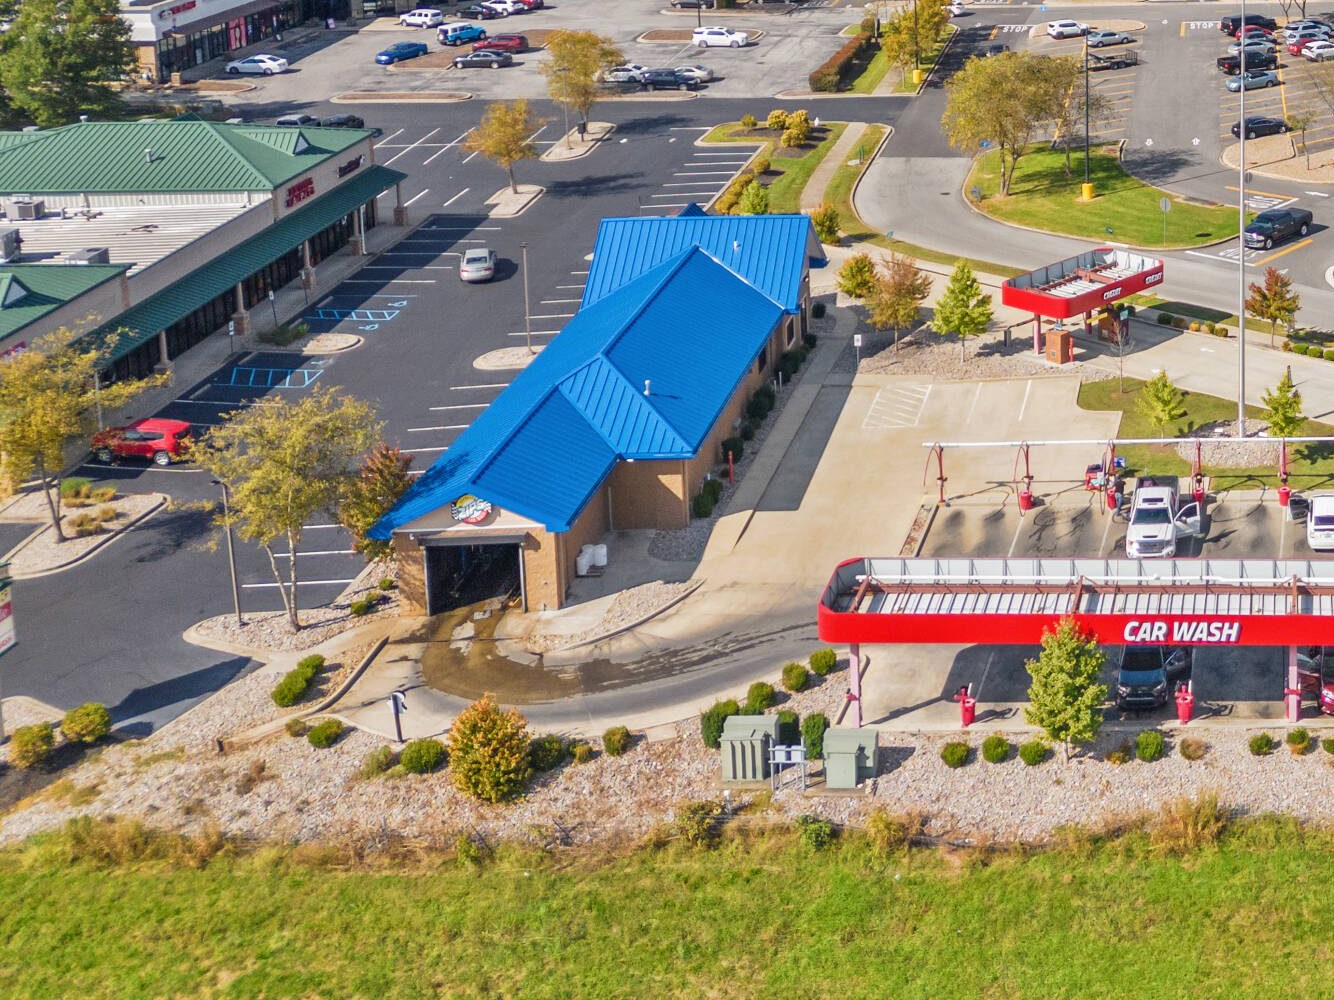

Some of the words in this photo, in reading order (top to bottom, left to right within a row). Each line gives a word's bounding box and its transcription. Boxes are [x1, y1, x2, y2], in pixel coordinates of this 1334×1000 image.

[1003, 25, 1028, 33] STOP
[1190, 22, 1214, 30] STOP
[1123, 620, 1168, 643] CAR
[1172, 620, 1241, 643] WASH
